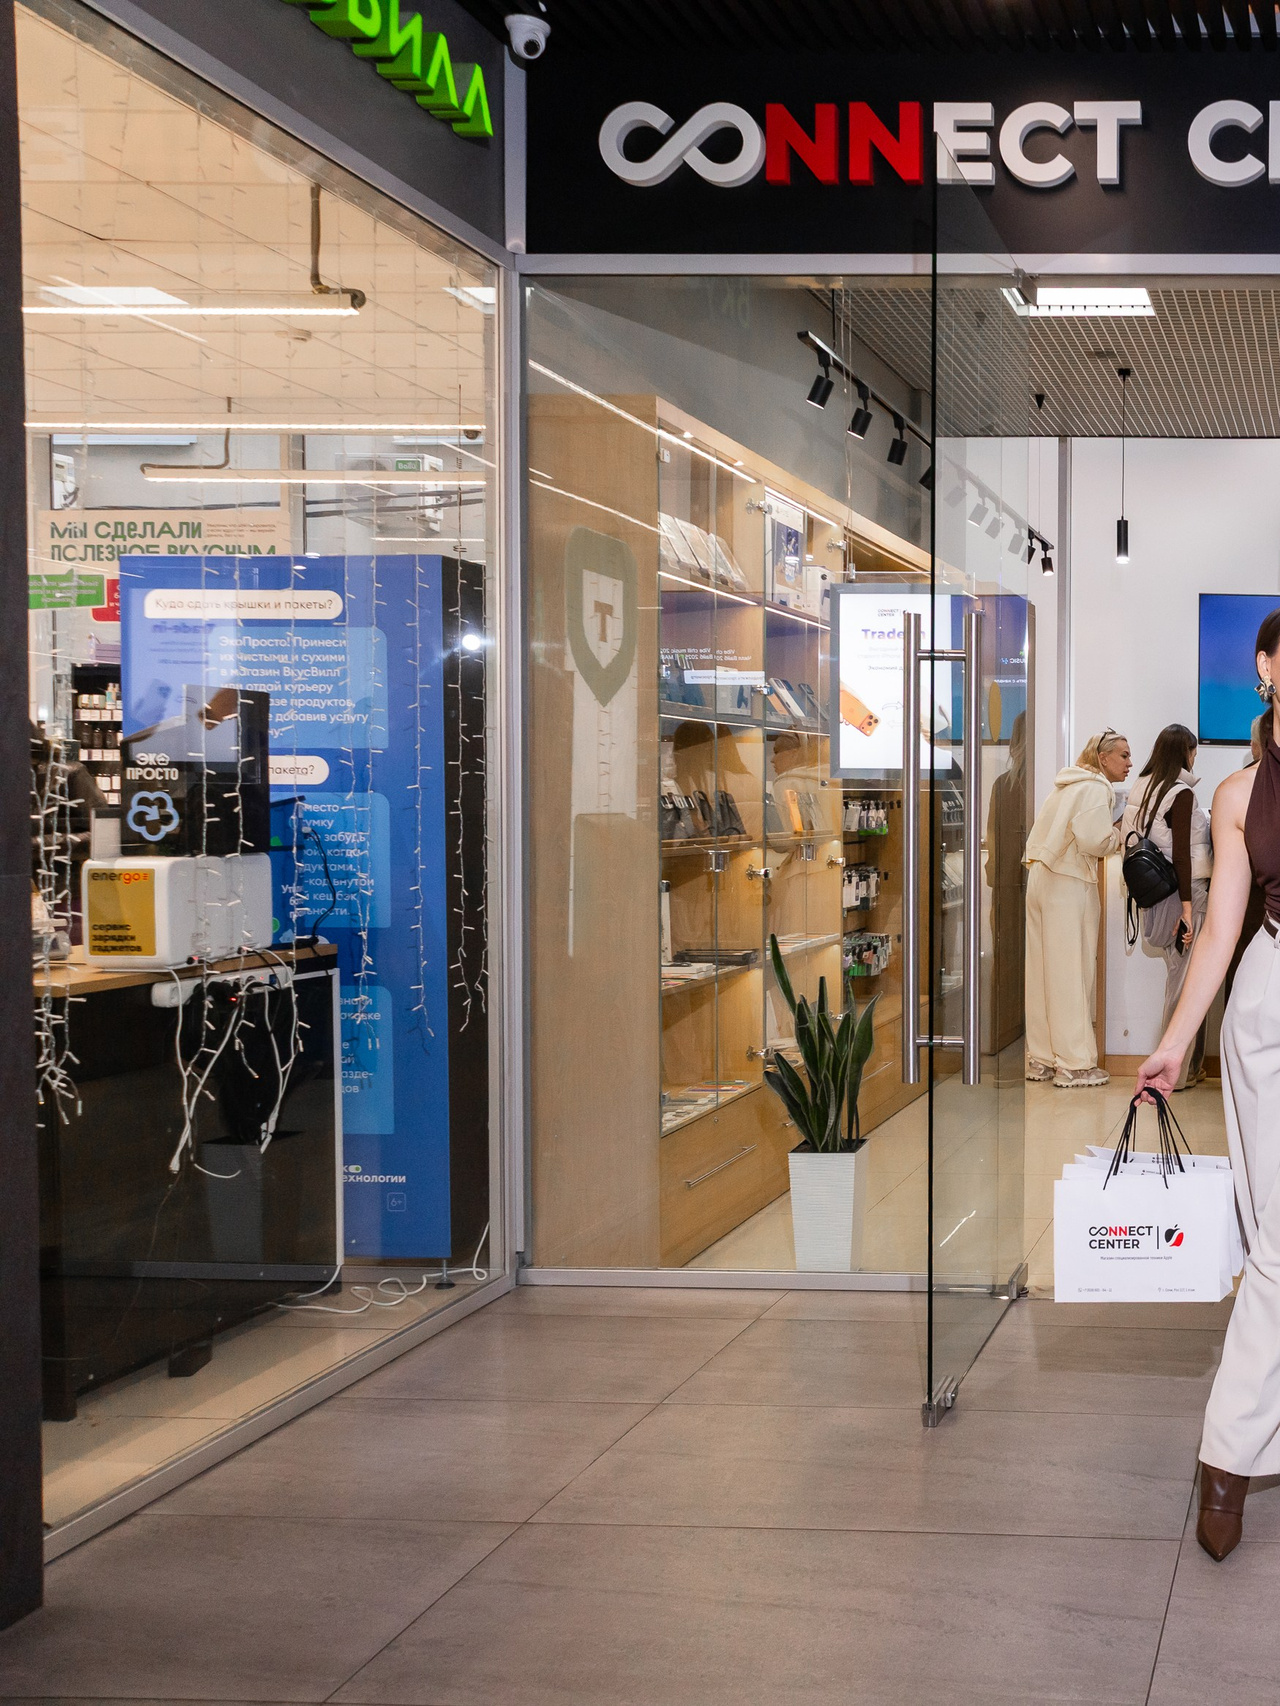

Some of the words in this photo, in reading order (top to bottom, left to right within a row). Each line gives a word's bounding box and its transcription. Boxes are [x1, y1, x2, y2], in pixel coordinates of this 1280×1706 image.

[598, 100, 1142, 187] CONNECT
[155, 598, 184, 610] Куда
[224, 601, 271, 611] крышки
[284, 599, 334, 610] пакеты?
[218, 635, 291, 649] ЭкоПросто!
[293, 636, 347, 649] Принеси
[301, 654, 346, 665] сухими
[283, 666, 341, 678] ВкусВилл
[284, 683, 334, 695] курьеру
[329, 713, 369, 724] услугу
[126, 767, 179, 781] ПРОСТО
[92, 872, 141, 885] energo
[92, 924, 132, 933] сервис
[92, 935, 137, 943] зарядки
[1089, 1226, 1153, 1237] CONNECT
[1089, 1239, 1140, 1249] CENTER
